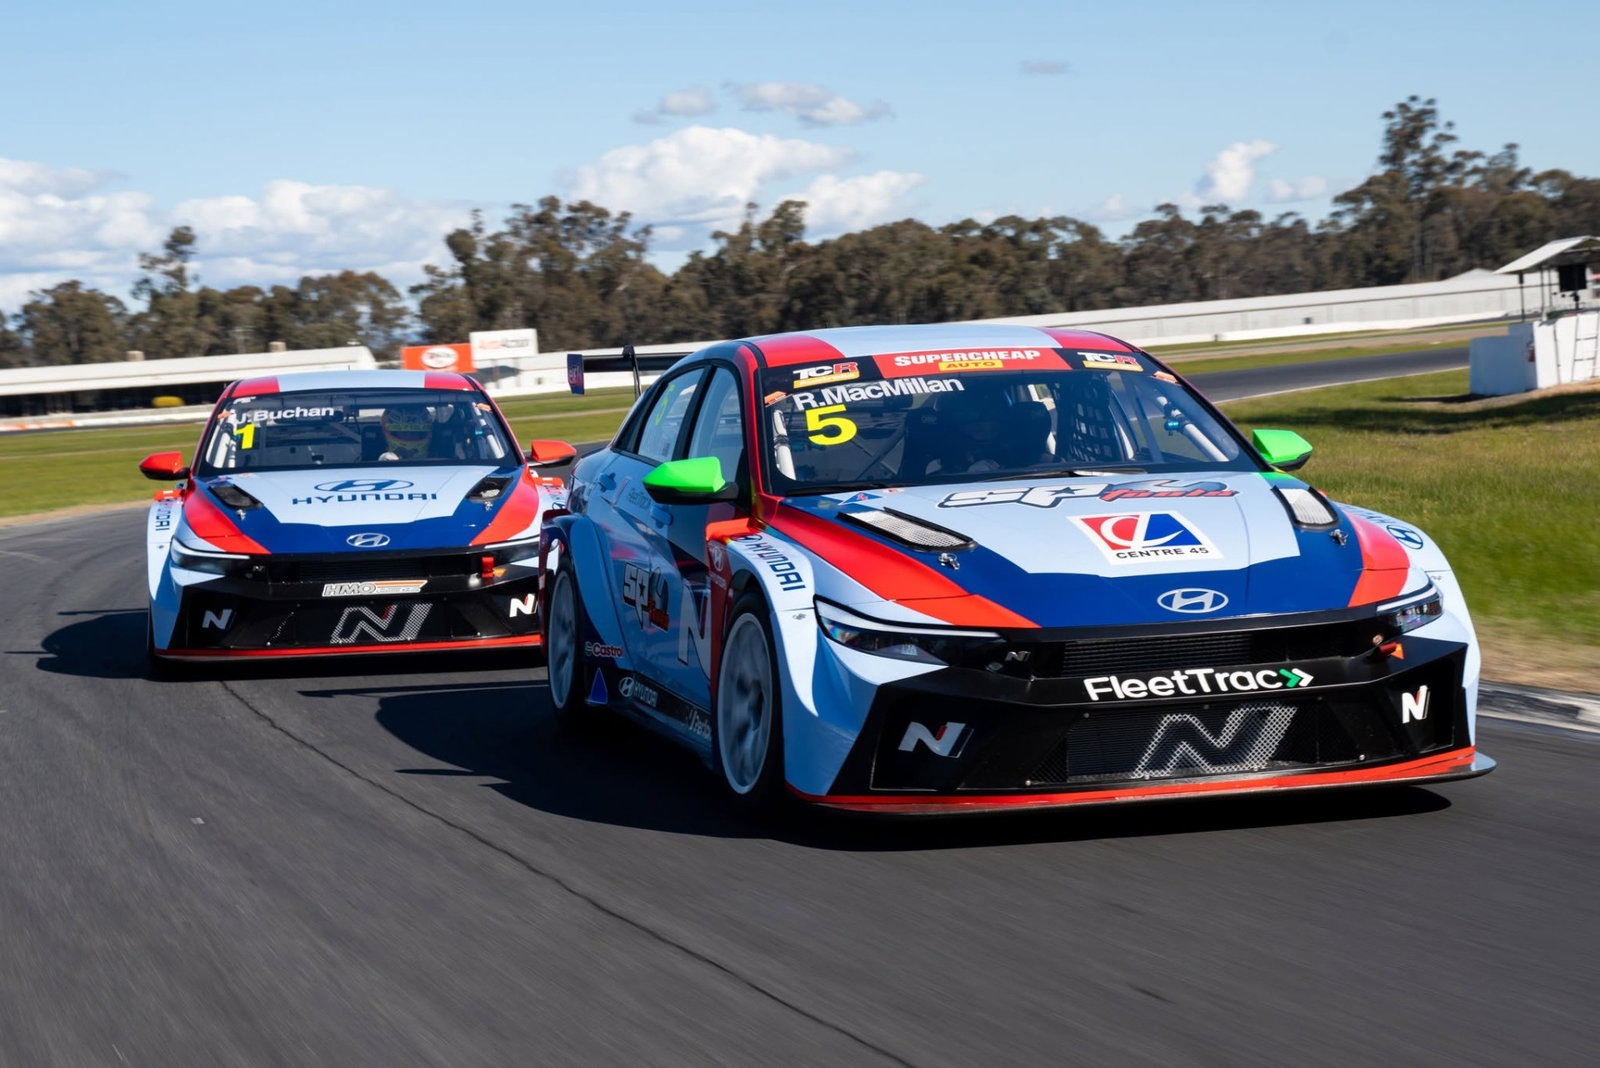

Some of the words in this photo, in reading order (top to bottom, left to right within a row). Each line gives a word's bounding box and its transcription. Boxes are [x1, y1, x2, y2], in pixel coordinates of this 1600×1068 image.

[793, 361, 858, 380] TCR
[894, 350, 1041, 366] SUPERCHEAP
[946, 361, 996, 369] AUTO
[1077, 352, 1137, 367] TCR
[792, 377, 965, 411] R.MacMillan
[234, 423, 255, 449] 1
[805, 404, 858, 445] 5
[292, 493, 438, 505] HYUNDAI
[744, 541, 806, 592] HYUNDAI
[1116, 549, 1186, 561] CENTRE
[1188, 547, 1210, 556] 45
[322, 582, 377, 597] HMO
[509, 593, 538, 617] N
[202, 608, 233, 630] N
[330, 603, 433, 644] N
[1083, 668, 1283, 701] FleetTrac
[1401, 684, 1431, 725] N
[898, 721, 973, 758] N
[1130, 705, 1298, 780] N
